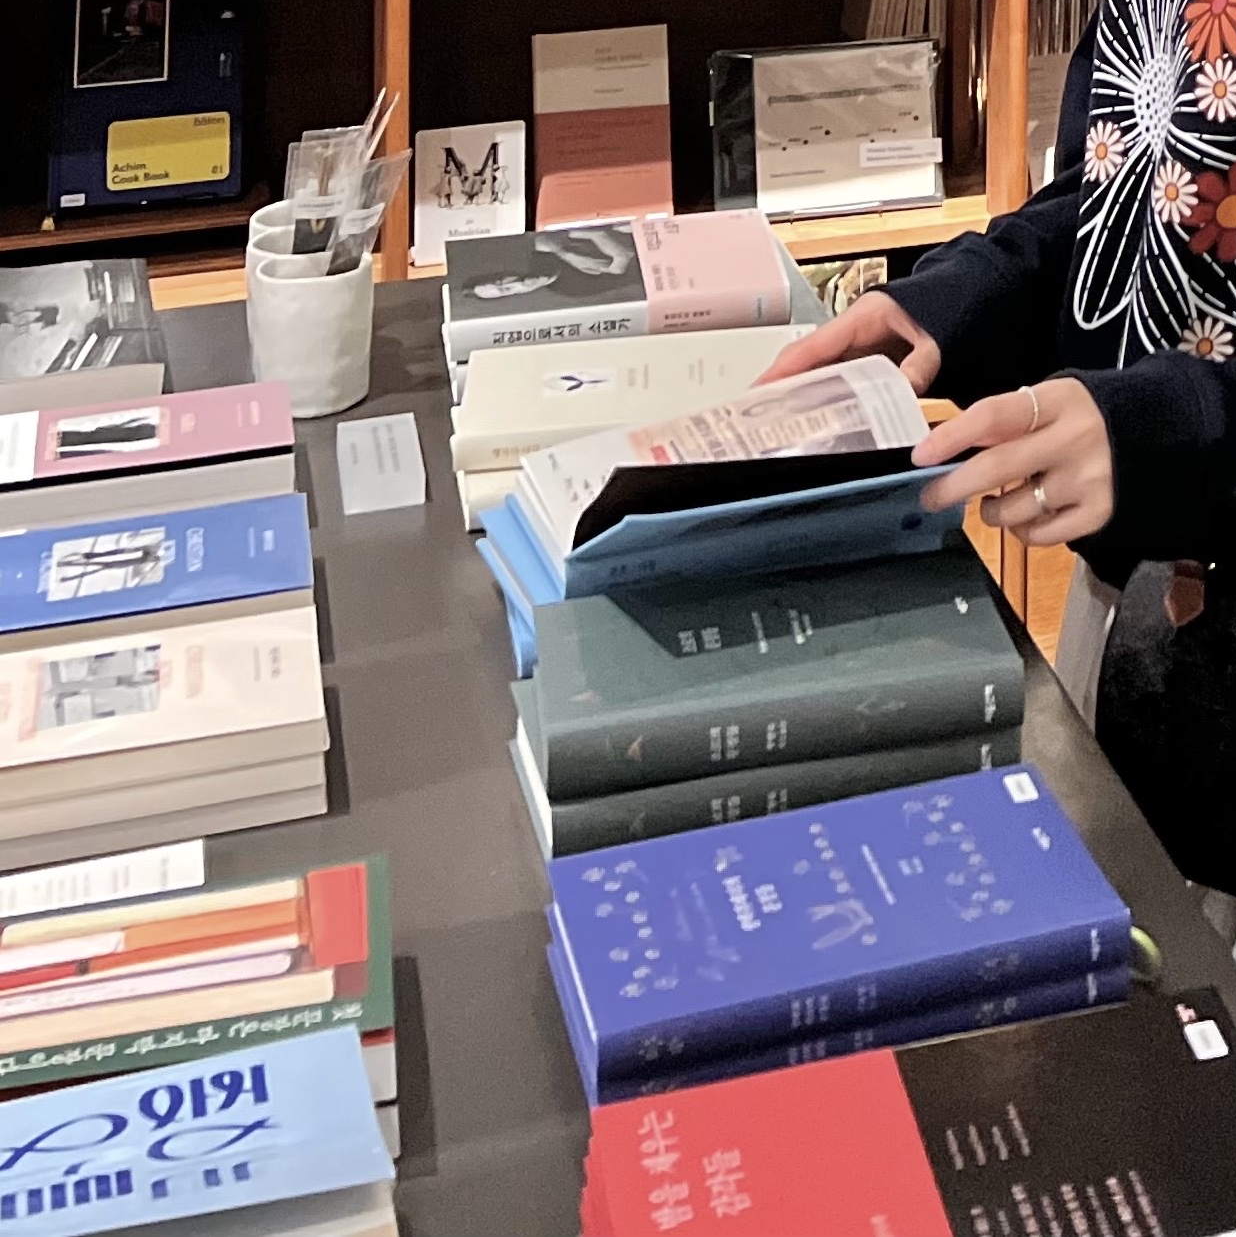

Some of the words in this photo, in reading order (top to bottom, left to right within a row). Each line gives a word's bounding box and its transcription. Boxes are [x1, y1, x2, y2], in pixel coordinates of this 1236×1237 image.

[112, 173, 140, 185] Cook
[144, 170, 170, 181] Book
[448, 227, 491, 238] Musician
[637, 1109, 681, 1177] 채우는
[641, 1179, 693, 1232] 밤을
[700, 1147, 753, 1219] 감각들
